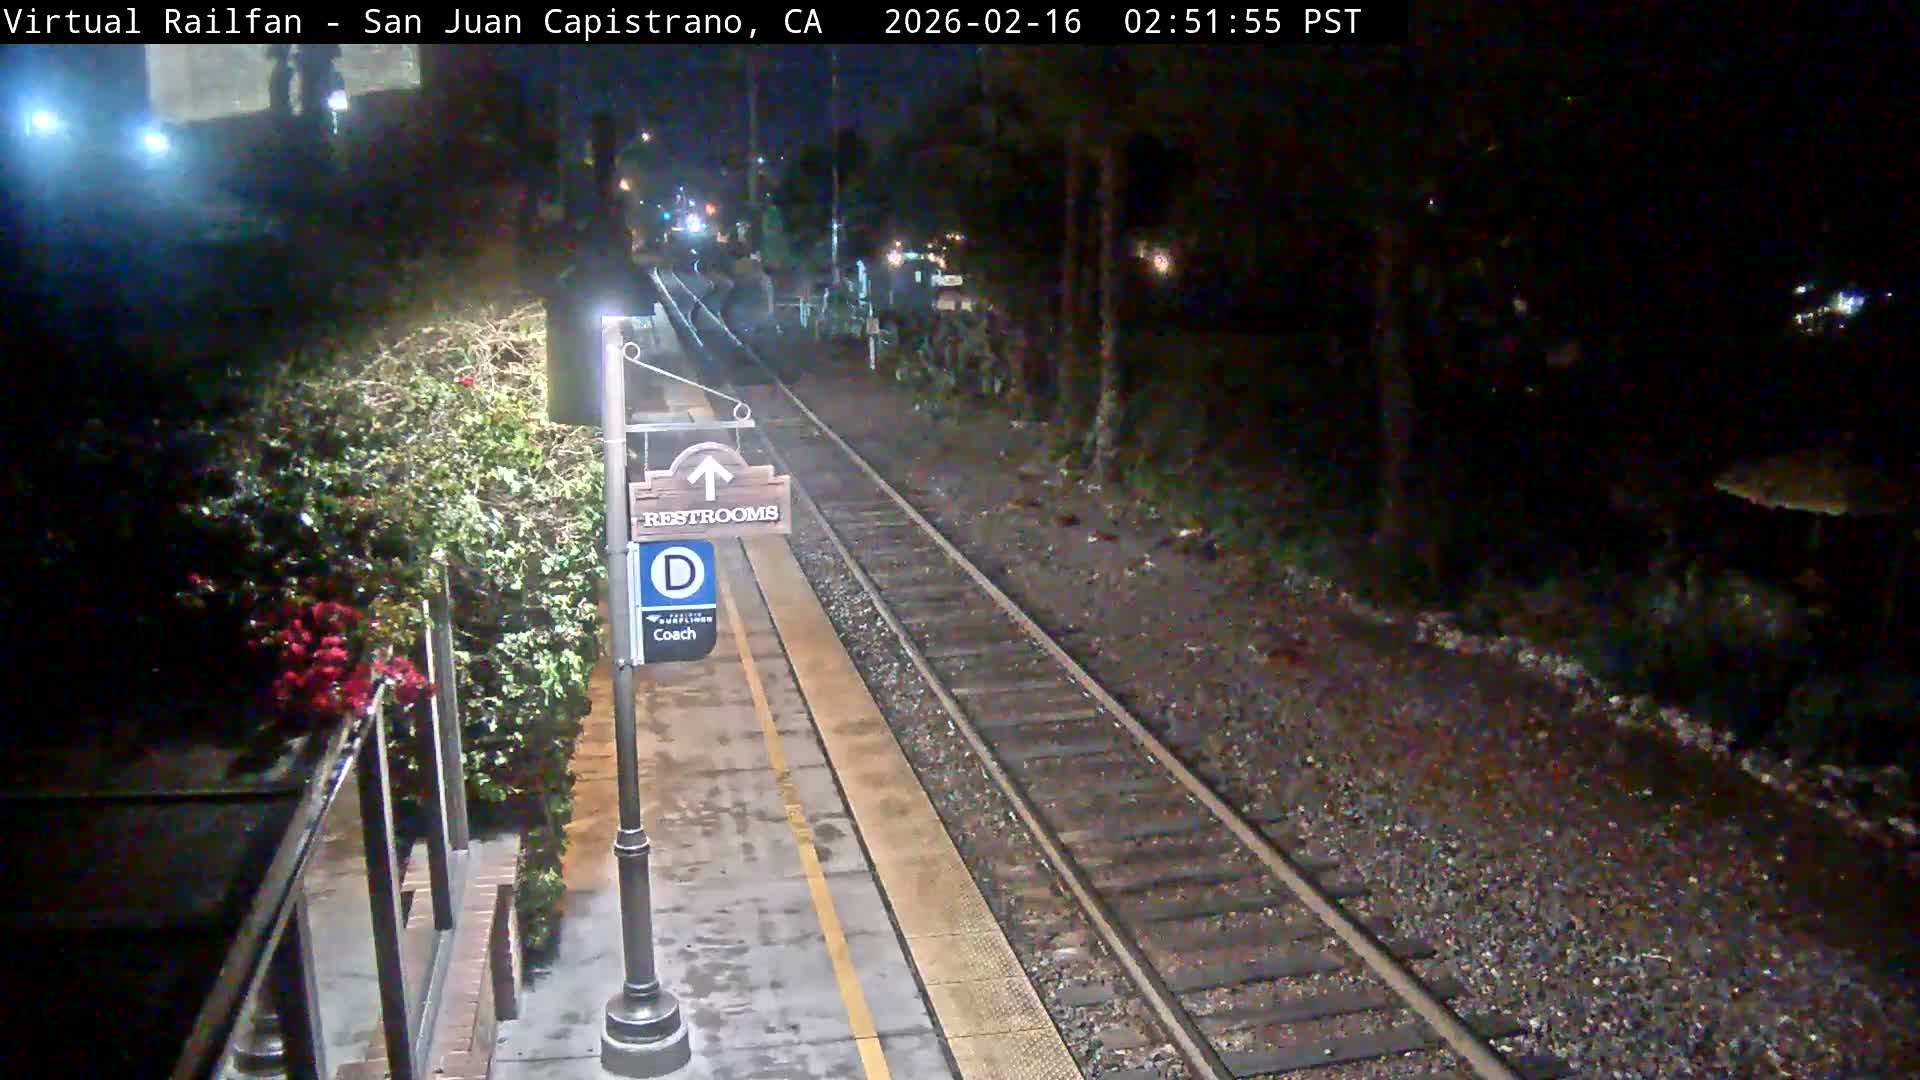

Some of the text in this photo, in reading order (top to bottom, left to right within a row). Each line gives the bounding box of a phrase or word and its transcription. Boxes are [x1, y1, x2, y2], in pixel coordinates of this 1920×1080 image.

[643, 505, 779, 527] RESTROOMS
[664, 554, 696, 591] D
[653, 626, 697, 641] Coach
